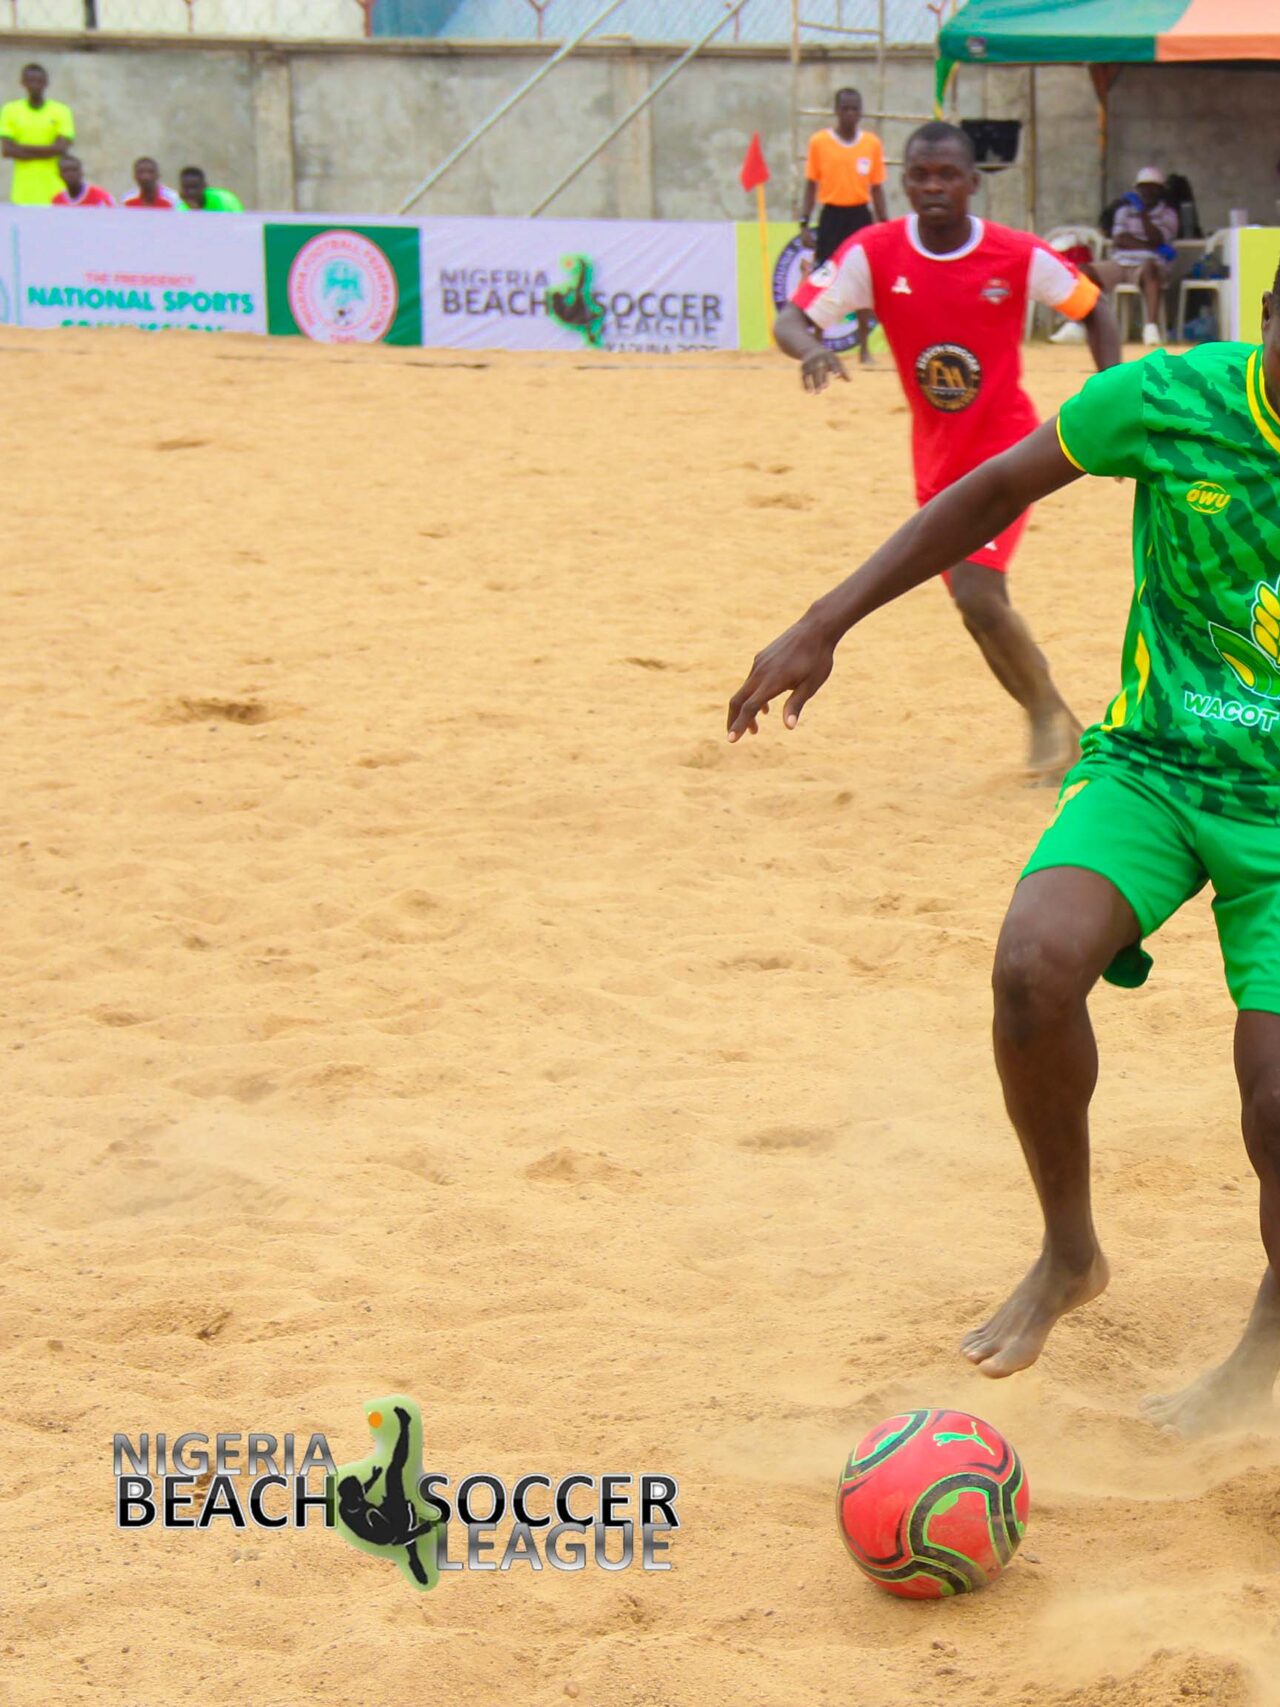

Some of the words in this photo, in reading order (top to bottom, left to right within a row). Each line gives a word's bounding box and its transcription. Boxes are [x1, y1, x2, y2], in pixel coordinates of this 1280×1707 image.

[439, 268, 549, 287] NIGERIA
[27, 286, 155, 311] NATIONAL
[163, 290, 254, 315] SPORTS
[441, 288, 551, 316] BEACH
[591, 291, 723, 321] SOCCER
[1184, 690, 1280, 732] WACOT
